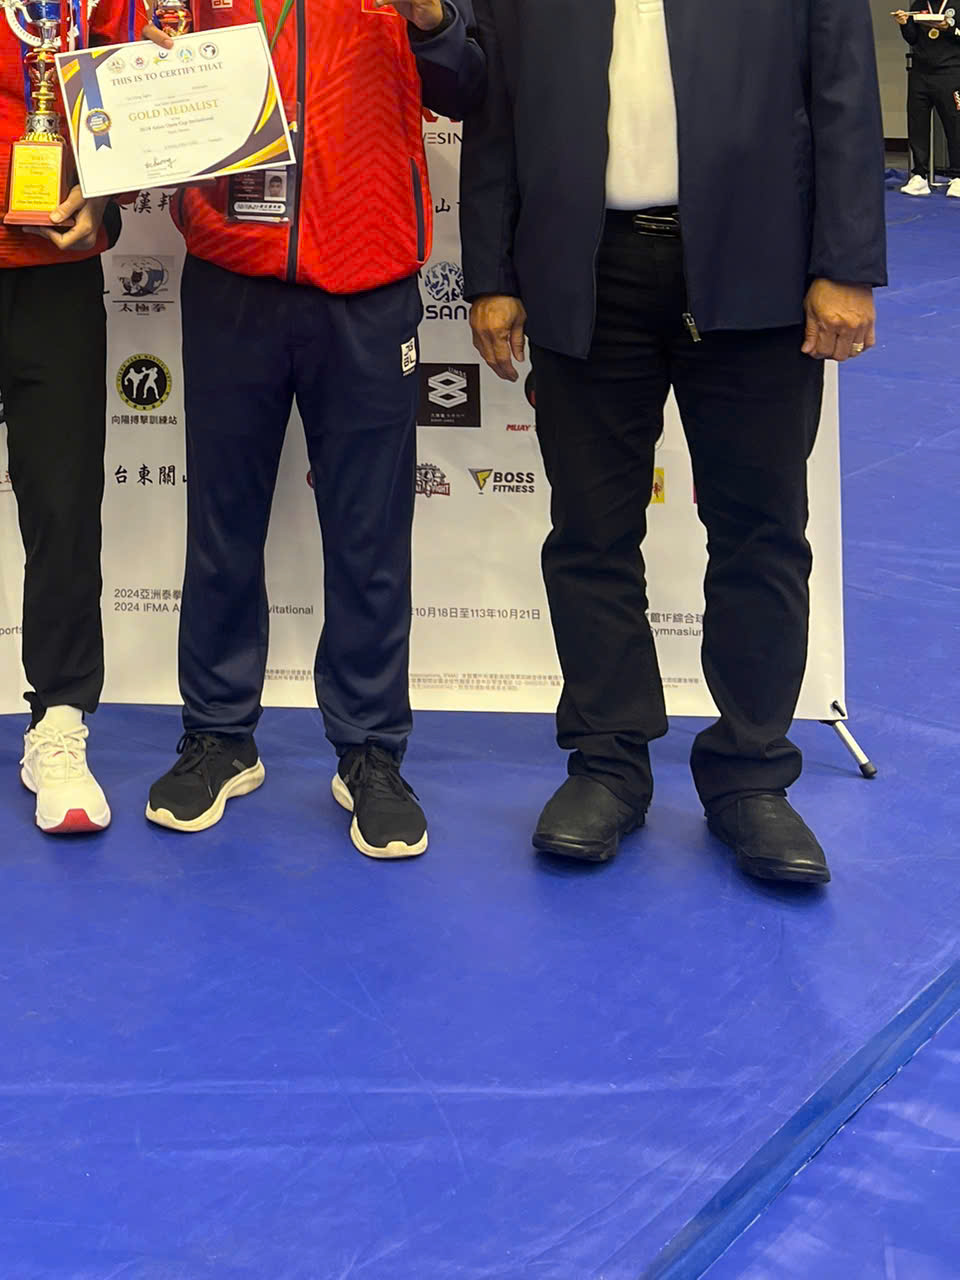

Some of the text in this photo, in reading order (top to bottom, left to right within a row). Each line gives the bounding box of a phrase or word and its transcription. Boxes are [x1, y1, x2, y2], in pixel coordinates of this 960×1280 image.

[111, 61, 224, 87] THIS IS TO CERTIFY THAT
[128, 98, 219, 122] GOLD MEDALIST
[505, 424, 531, 432] MUAY
[492, 471, 535, 483] BOSS
[492, 484, 535, 493] FITNESS
[114, 602, 140, 612] 2024
[143, 602, 170, 613] IFMA
